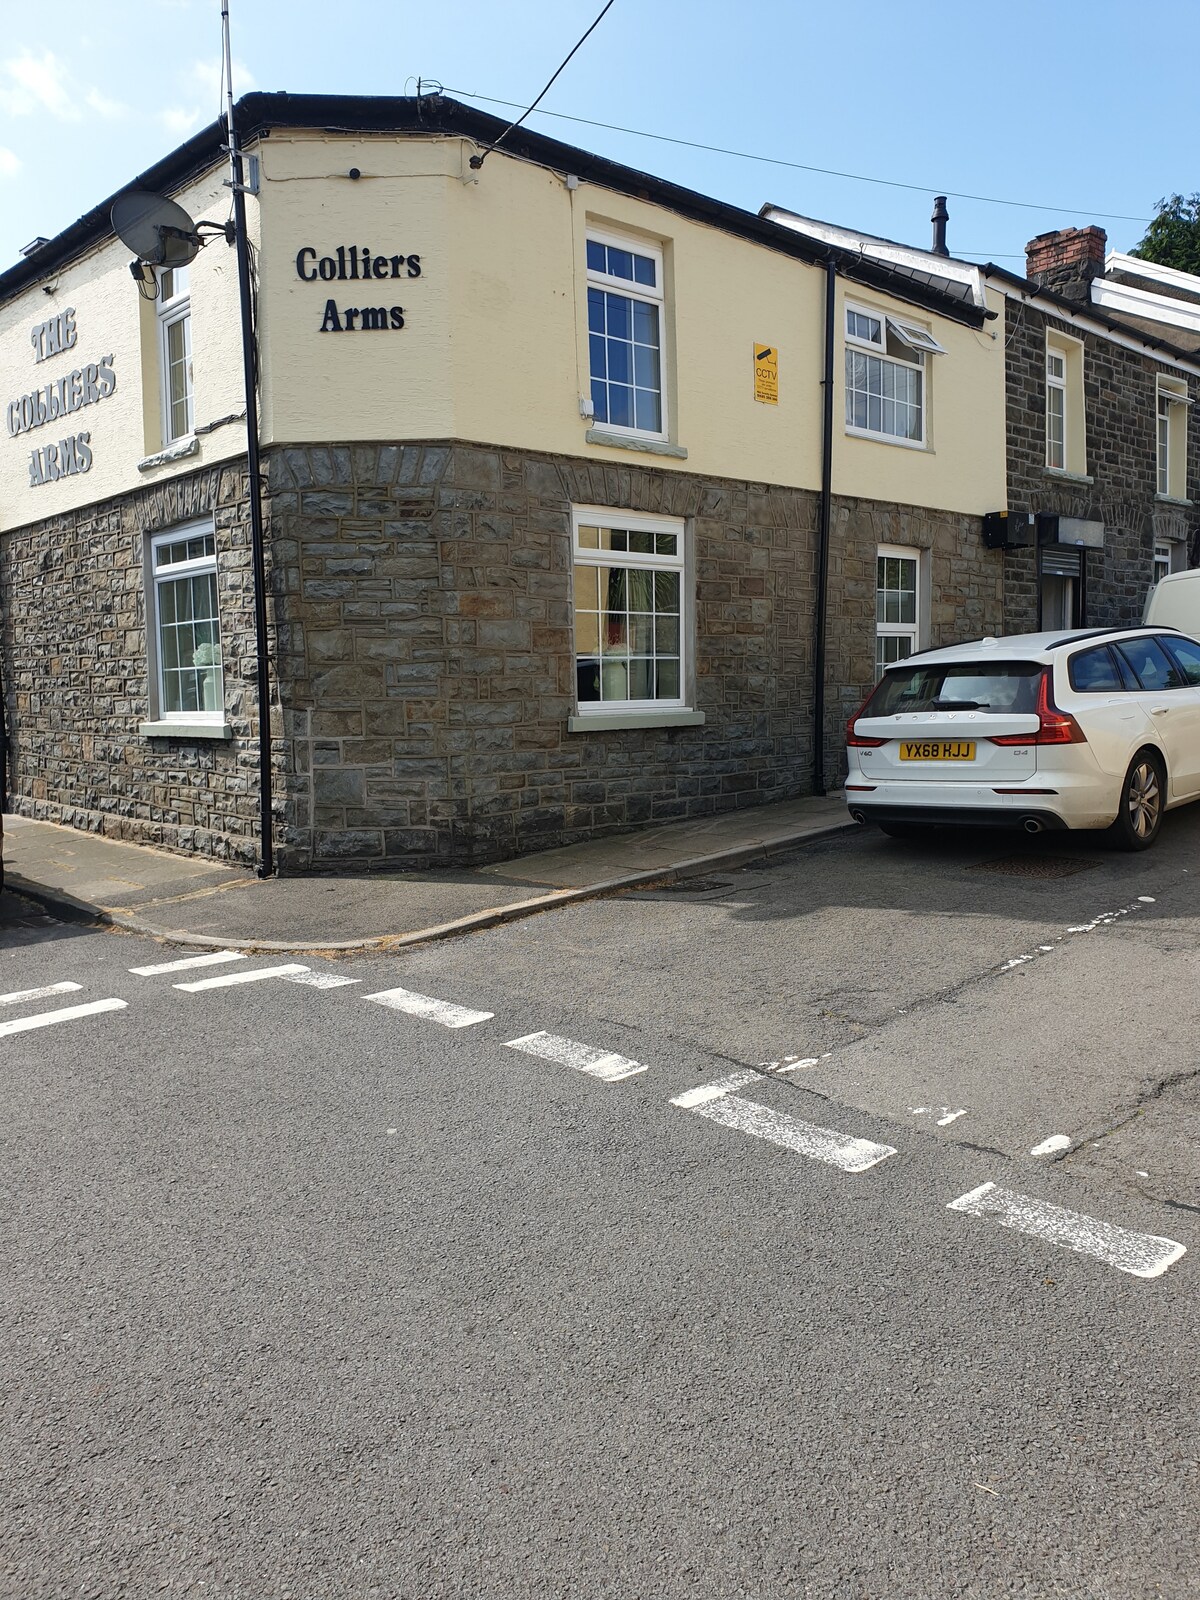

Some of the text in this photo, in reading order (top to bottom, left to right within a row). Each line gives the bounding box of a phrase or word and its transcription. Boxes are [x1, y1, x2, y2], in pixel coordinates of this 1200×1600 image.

[296, 245, 421, 281] Colliers
[320, 299, 405, 332] Arms
[31, 307, 77, 364] THE
[756, 367, 777, 380] CCTV
[7, 353, 117, 437] COLLIERS
[29, 431, 93, 487] ARMS
[906, 743, 970, 757] YX68 HJJ
